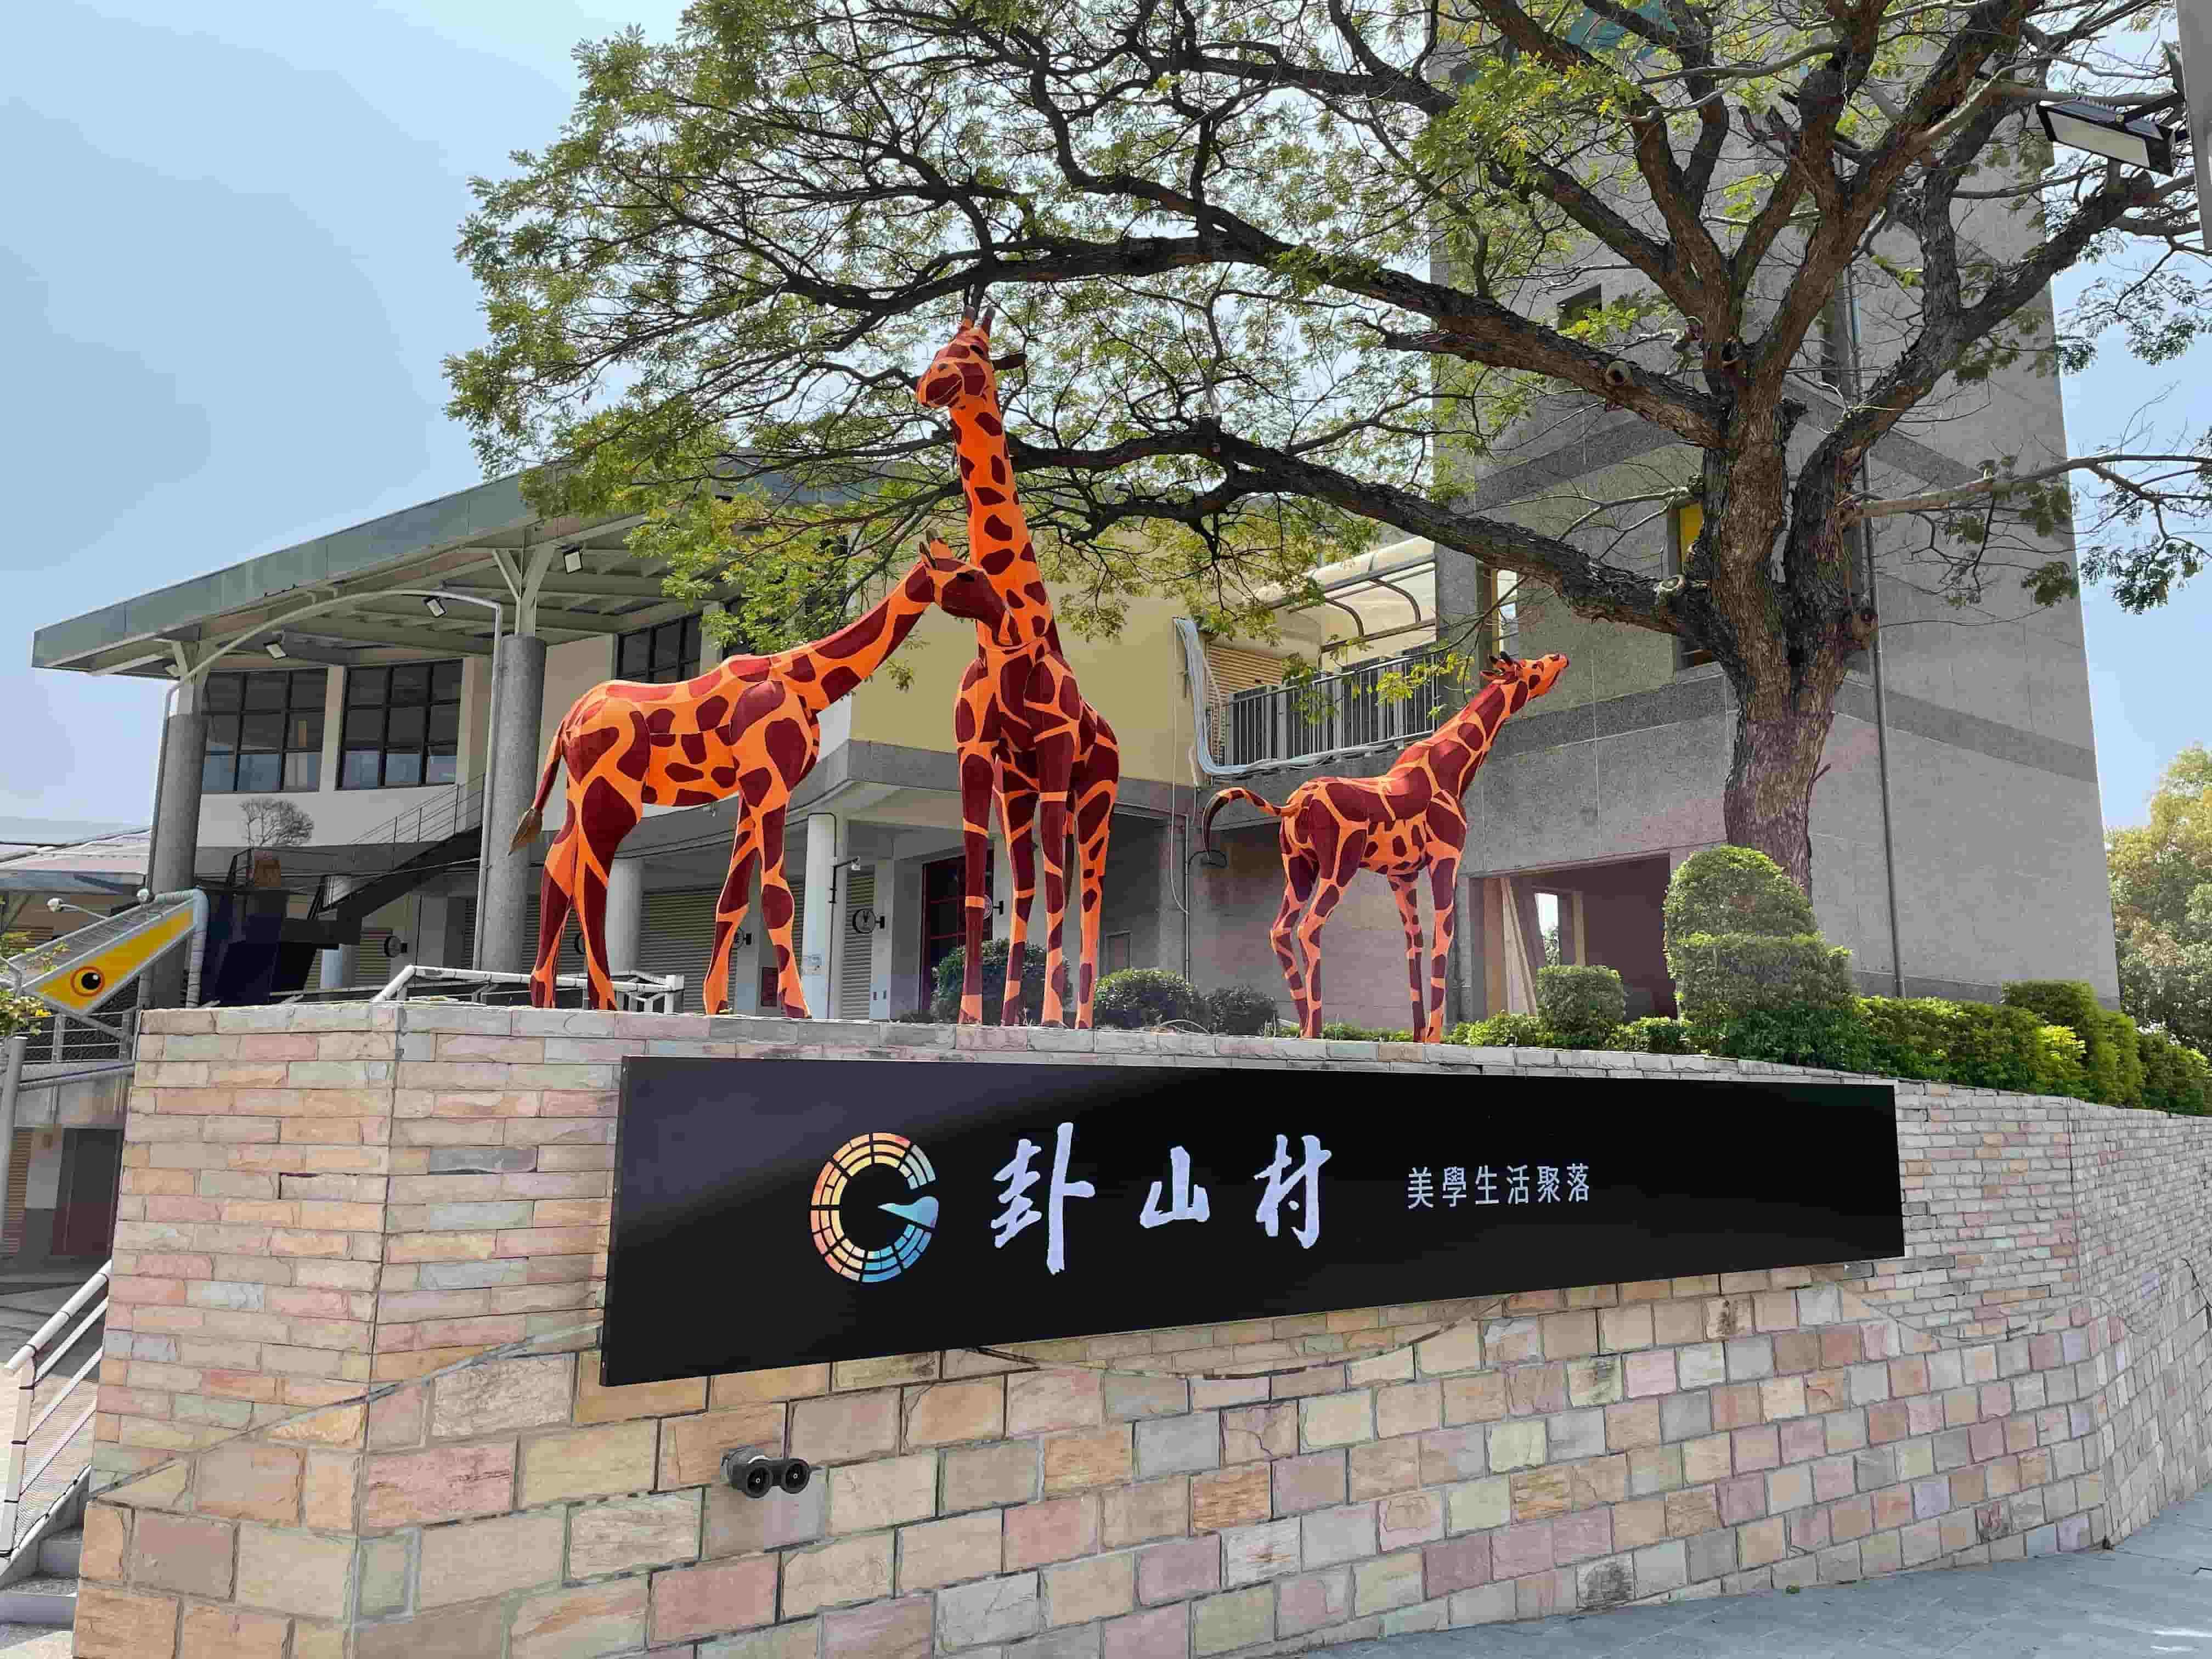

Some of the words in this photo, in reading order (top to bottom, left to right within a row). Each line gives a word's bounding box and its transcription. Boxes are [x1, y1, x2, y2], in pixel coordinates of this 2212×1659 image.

[990, 1122, 1332, 1275] 卦山村
[1408, 1163, 1589, 1209] 美學生活聚落
